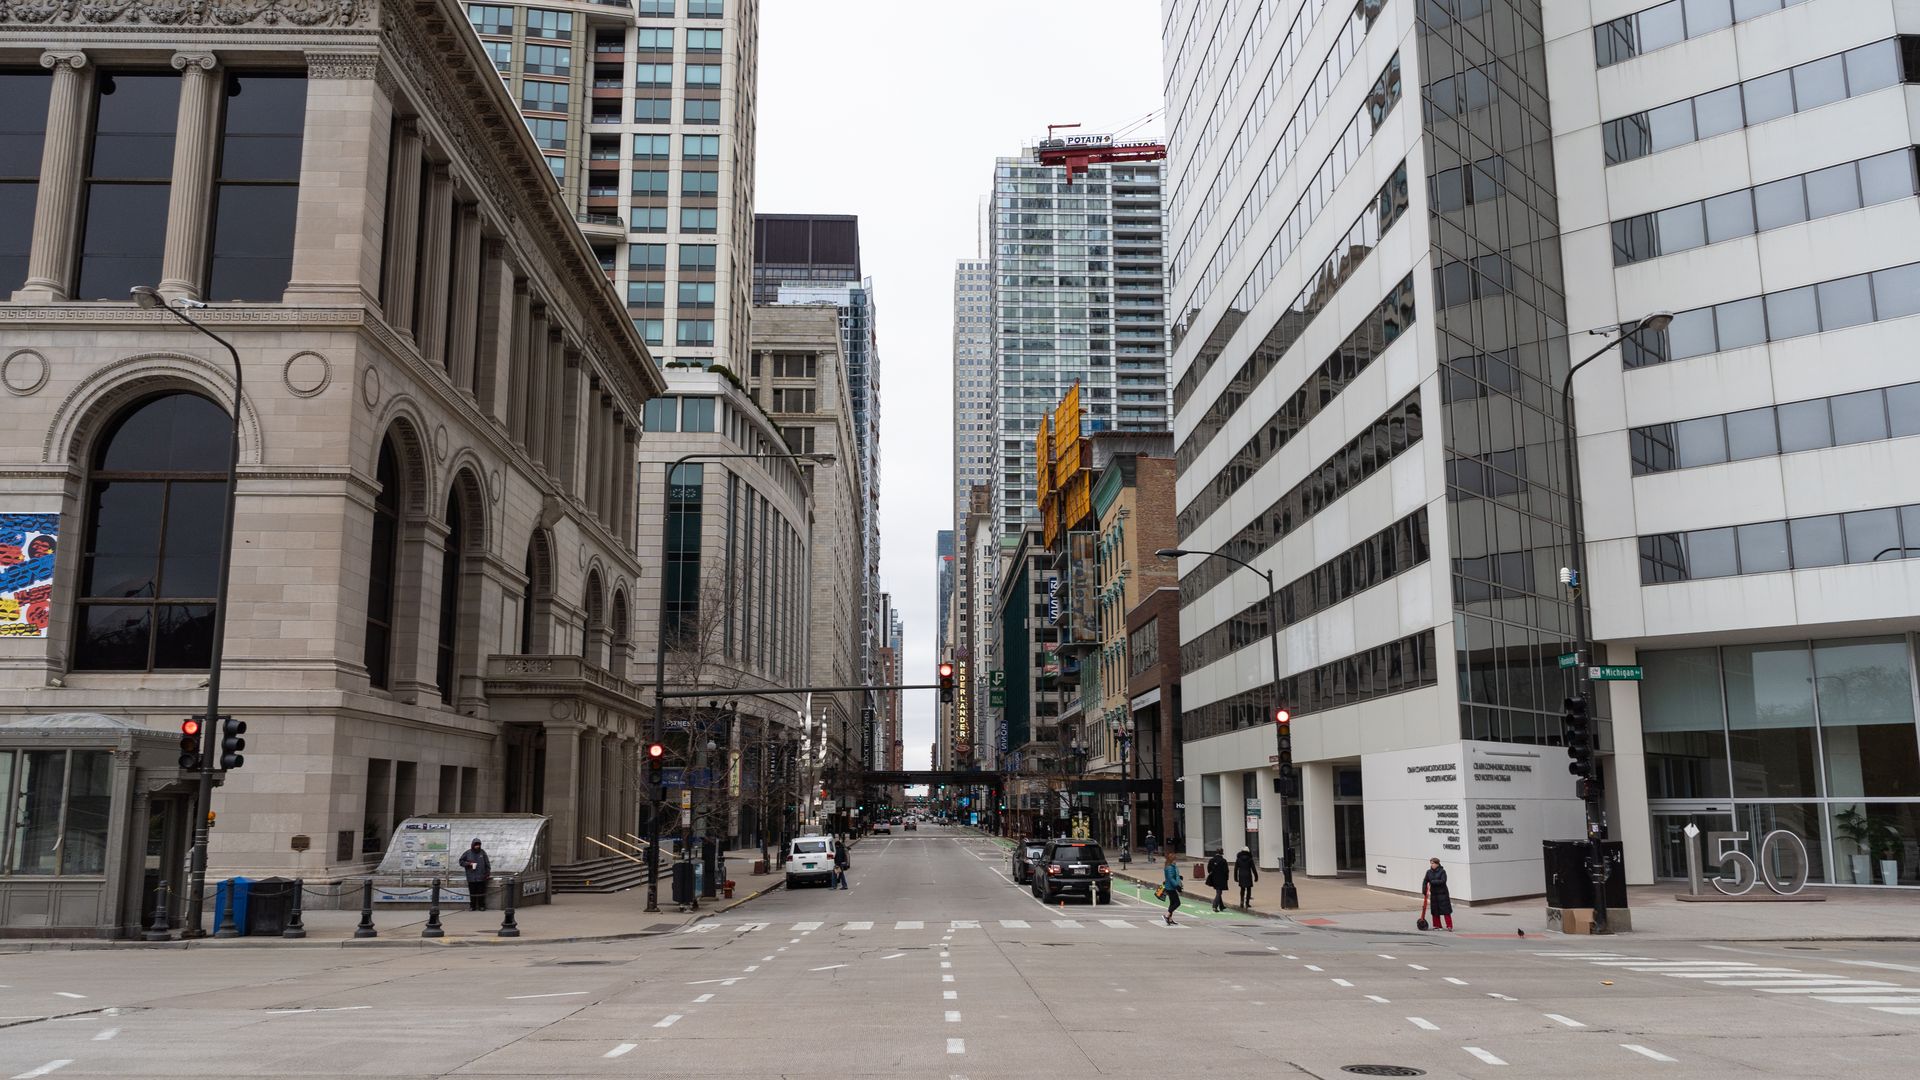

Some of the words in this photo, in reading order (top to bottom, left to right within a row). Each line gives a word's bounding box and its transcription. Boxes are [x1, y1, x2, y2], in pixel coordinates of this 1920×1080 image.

[1068, 136, 1102, 144] POTAIN
[1605, 668, 1634, 679] Michigan
[1684, 823, 1808, 895] 150
